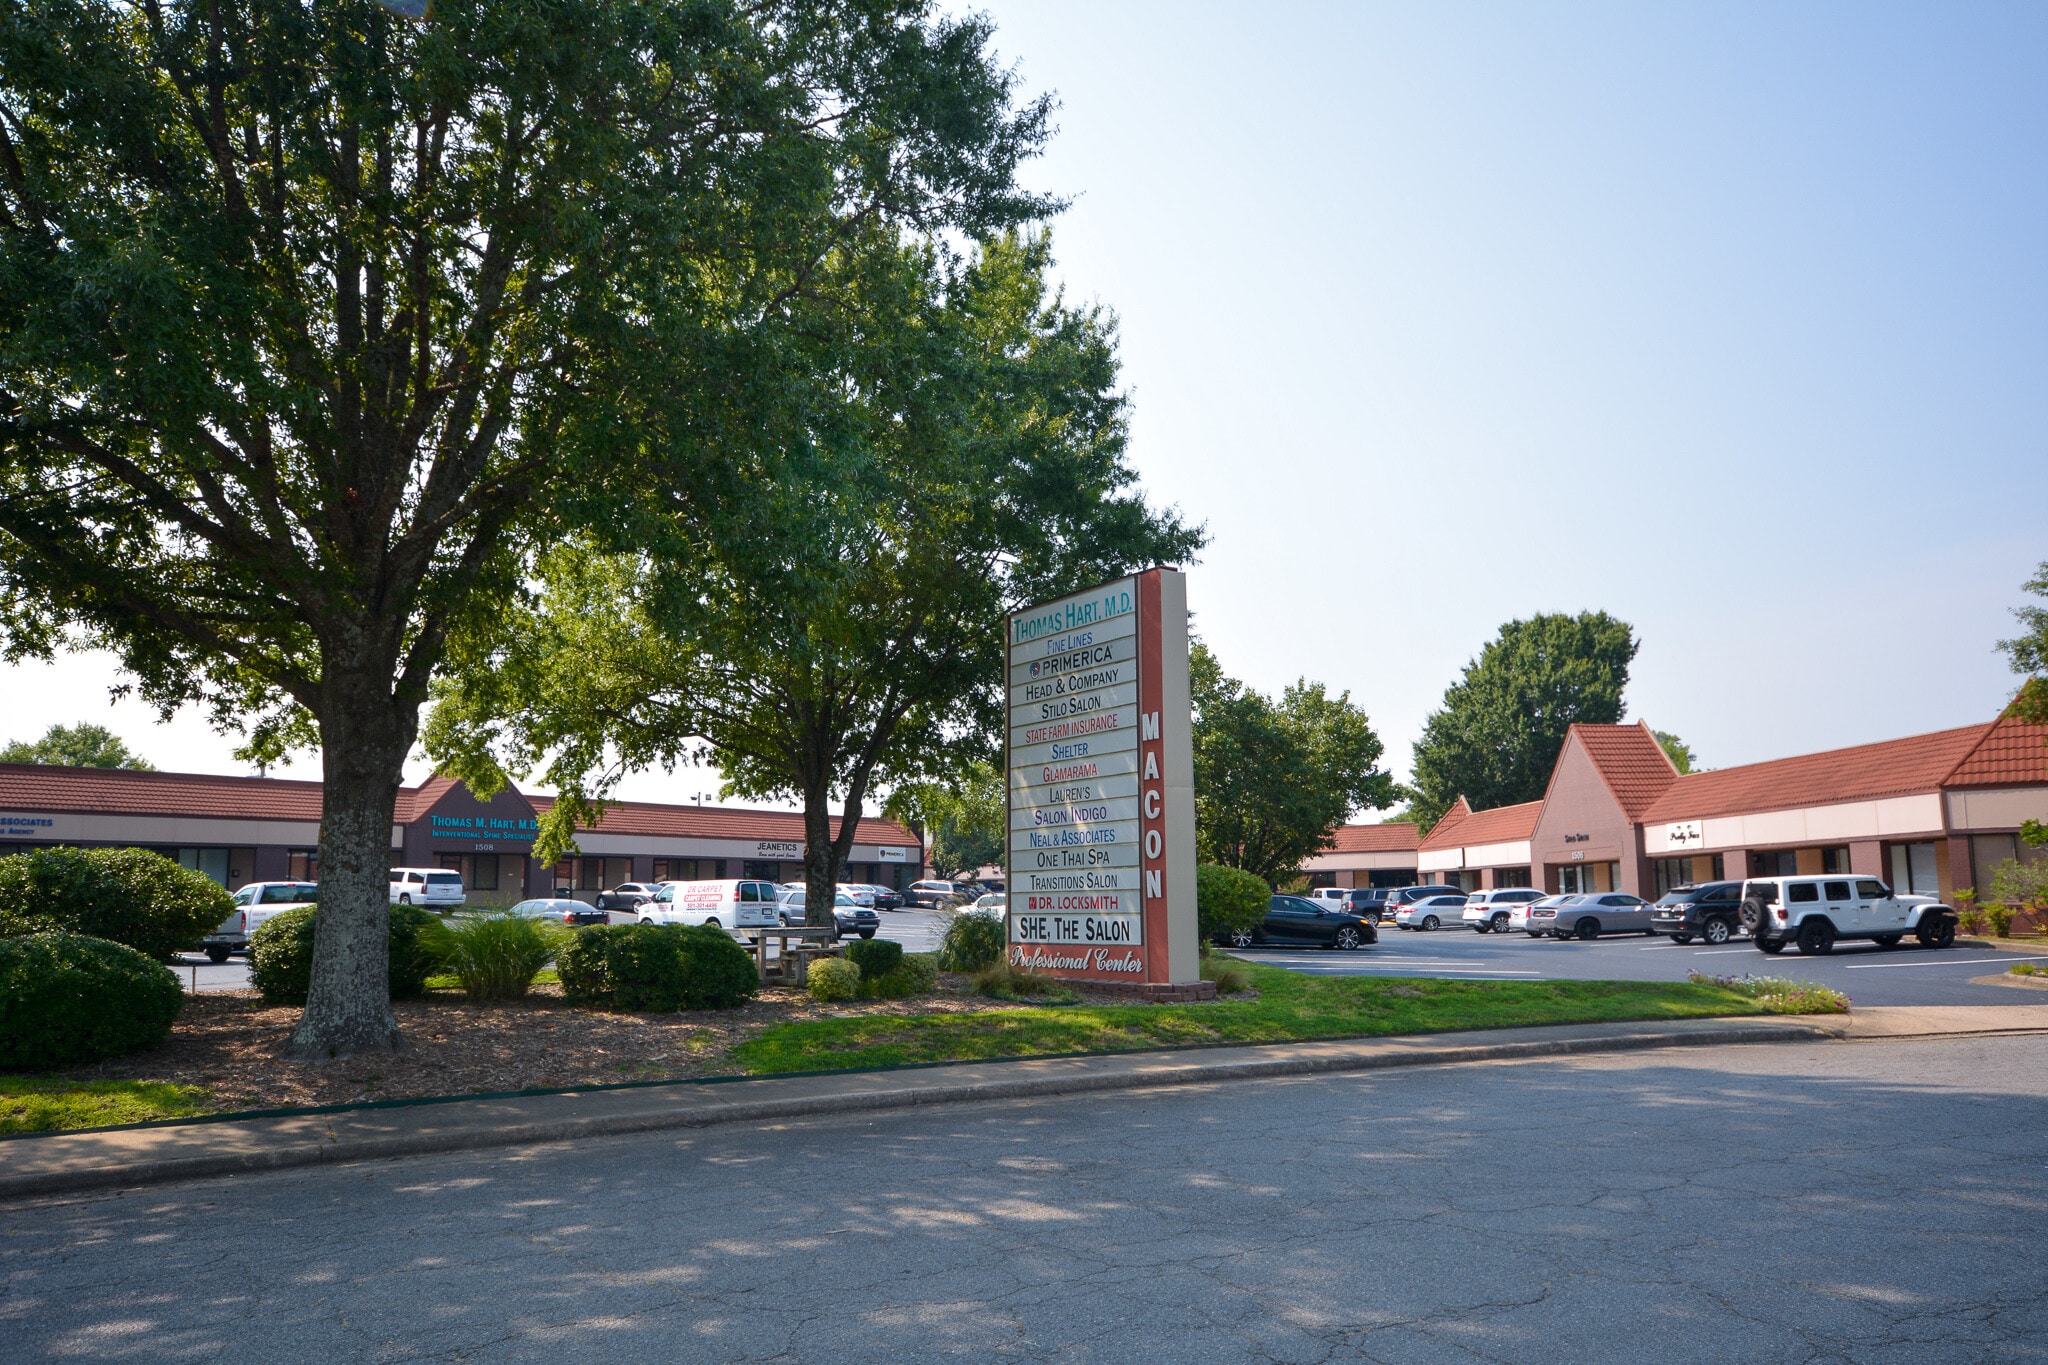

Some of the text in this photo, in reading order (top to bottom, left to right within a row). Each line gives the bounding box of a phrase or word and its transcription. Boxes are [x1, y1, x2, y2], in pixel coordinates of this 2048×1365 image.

[1014, 612, 1062, 643] THOMAS
[1105, 592, 1132, 614] M.D.
[1047, 631, 1093, 655] FINE LINES
[1042, 645, 1112, 676] PRIMERICA
[1026, 668, 1119, 701] HEAD & COMPANY
[1041, 695, 1101, 720] STILO SALON
[1025, 713, 1118, 744] STATE FARM INSURANCE
[1051, 742, 1089, 760] SHELTER
[1043, 763, 1098, 783] GLAMARAMA
[1049, 786, 1091, 803] LAUREN'S
[1142, 711, 1162, 899] MACON
[431, 815, 472, 828] THOMAS
[475, 817, 487, 828] M.
[489, 818, 516, 830] HART,
[1034, 806, 1107, 826] SALON INDIGO
[432, 829, 535, 840] INTERVENTIONAL SPINE SPECIALIST
[1030, 829, 1115, 848] NEAL & ASSOCIATES
[475, 843, 494, 851] 1508
[757, 842, 797, 851] JEANETICS
[1037, 848, 1110, 867] ONE THAI SPA
[698, 885, 723, 893] CARPET
[1030, 872, 1118, 891] TRANSITIONS SALON
[1039, 896, 1119, 910] DR. LOCKSMITH
[1054, 917, 1079, 940] THE
[1085, 917, 1130, 942] SALON
[1010, 945, 1143, 974] Professional Center
